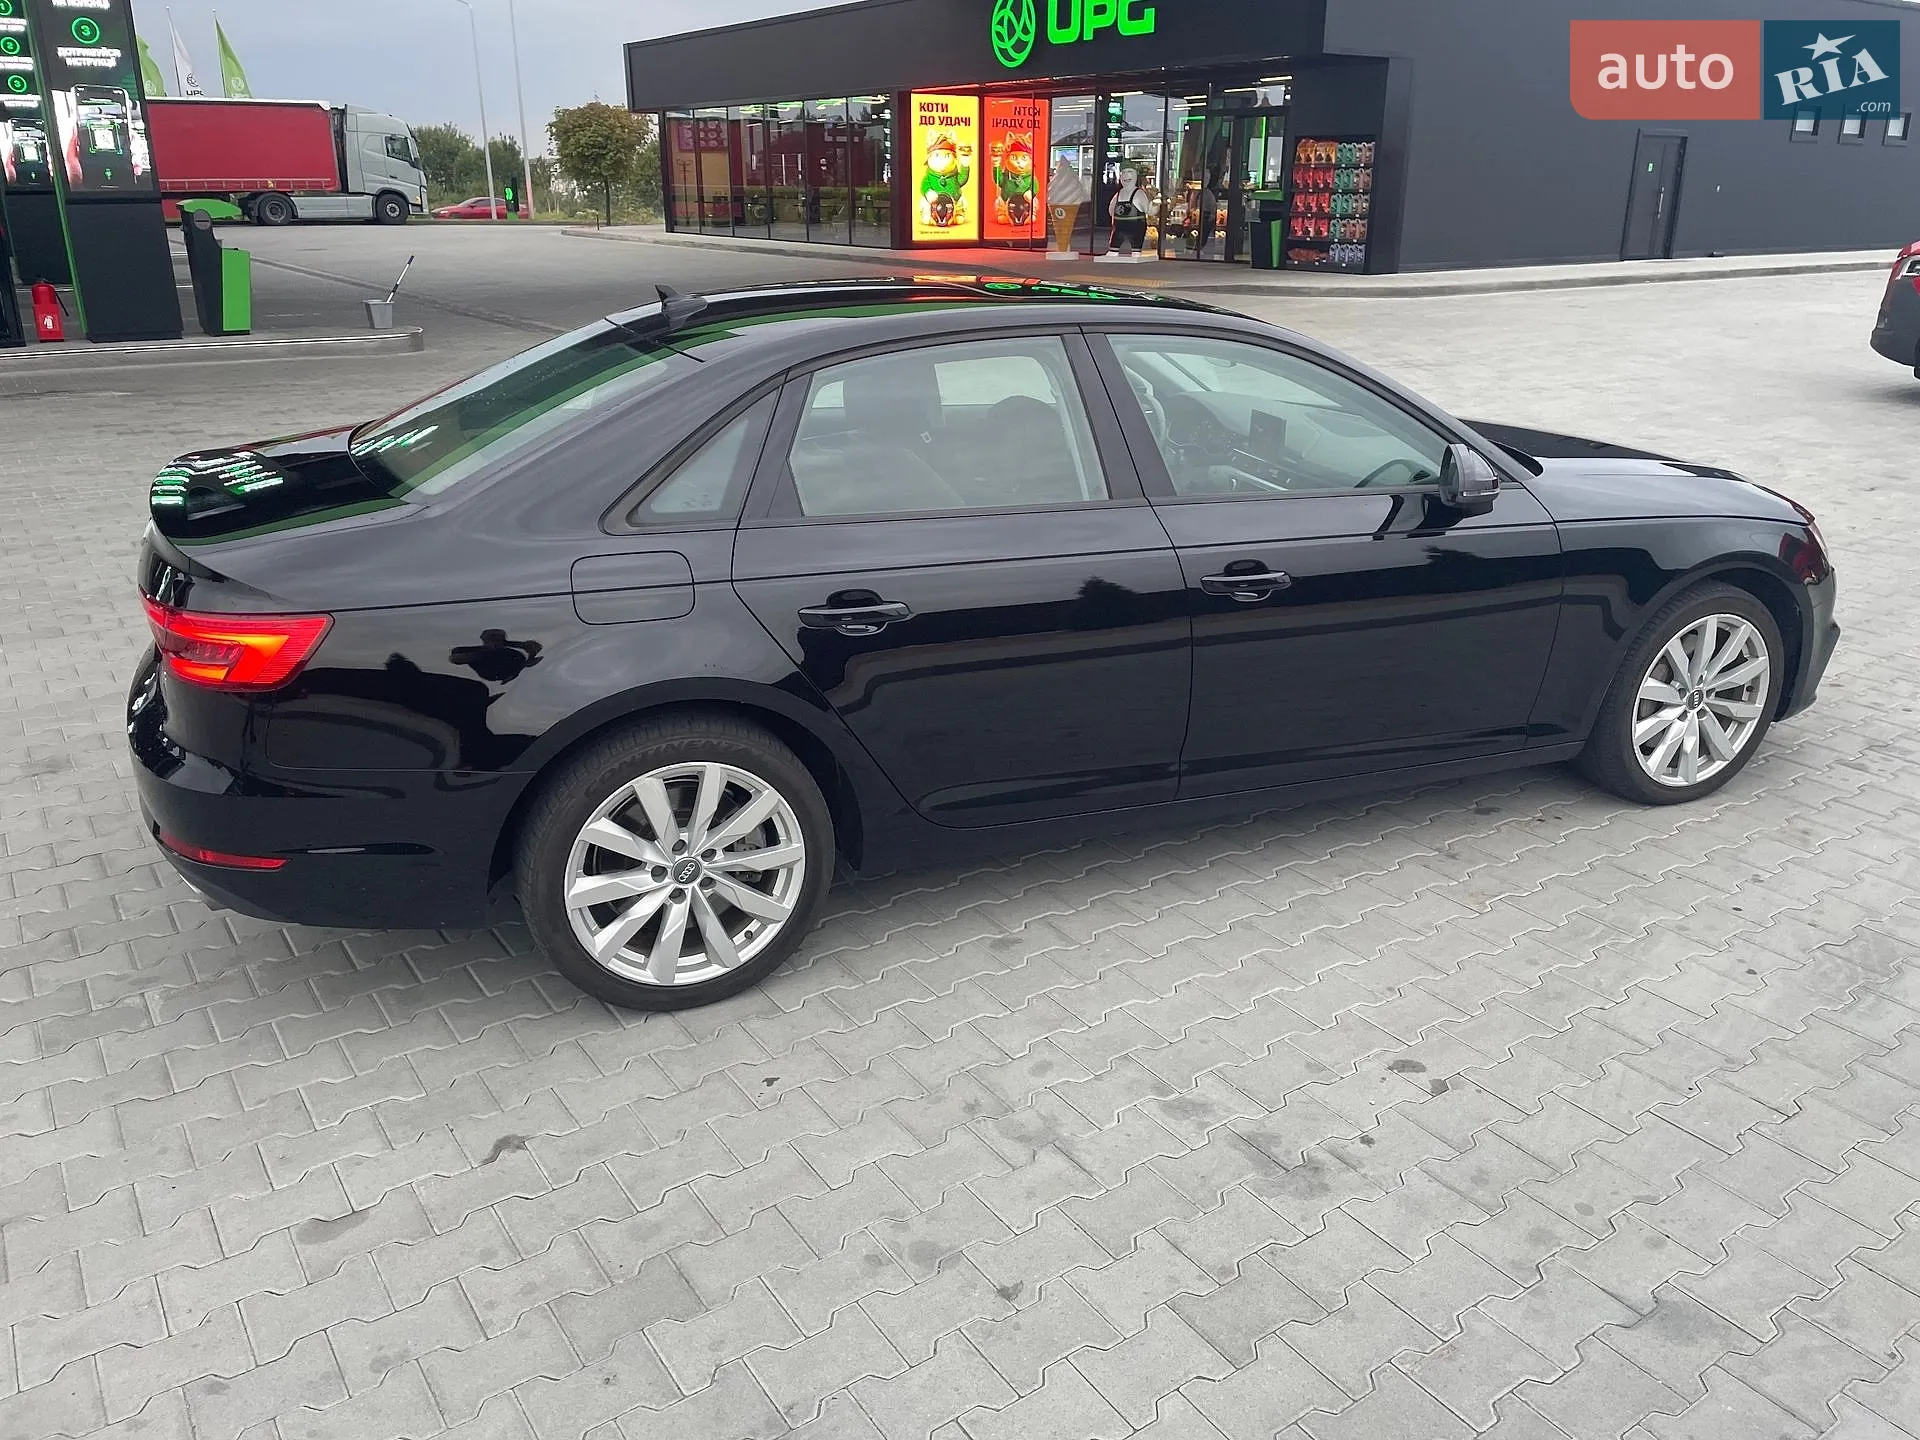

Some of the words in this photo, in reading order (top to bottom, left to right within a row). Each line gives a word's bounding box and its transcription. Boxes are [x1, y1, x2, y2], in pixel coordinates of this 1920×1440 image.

[1047, 0, 1155, 44] UPG
[80, 25, 90, 36] 3
[919, 102, 949, 113] КОТИ
[919, 115, 935, 126] ДО
[938, 116, 971, 127] УДАЧІ
